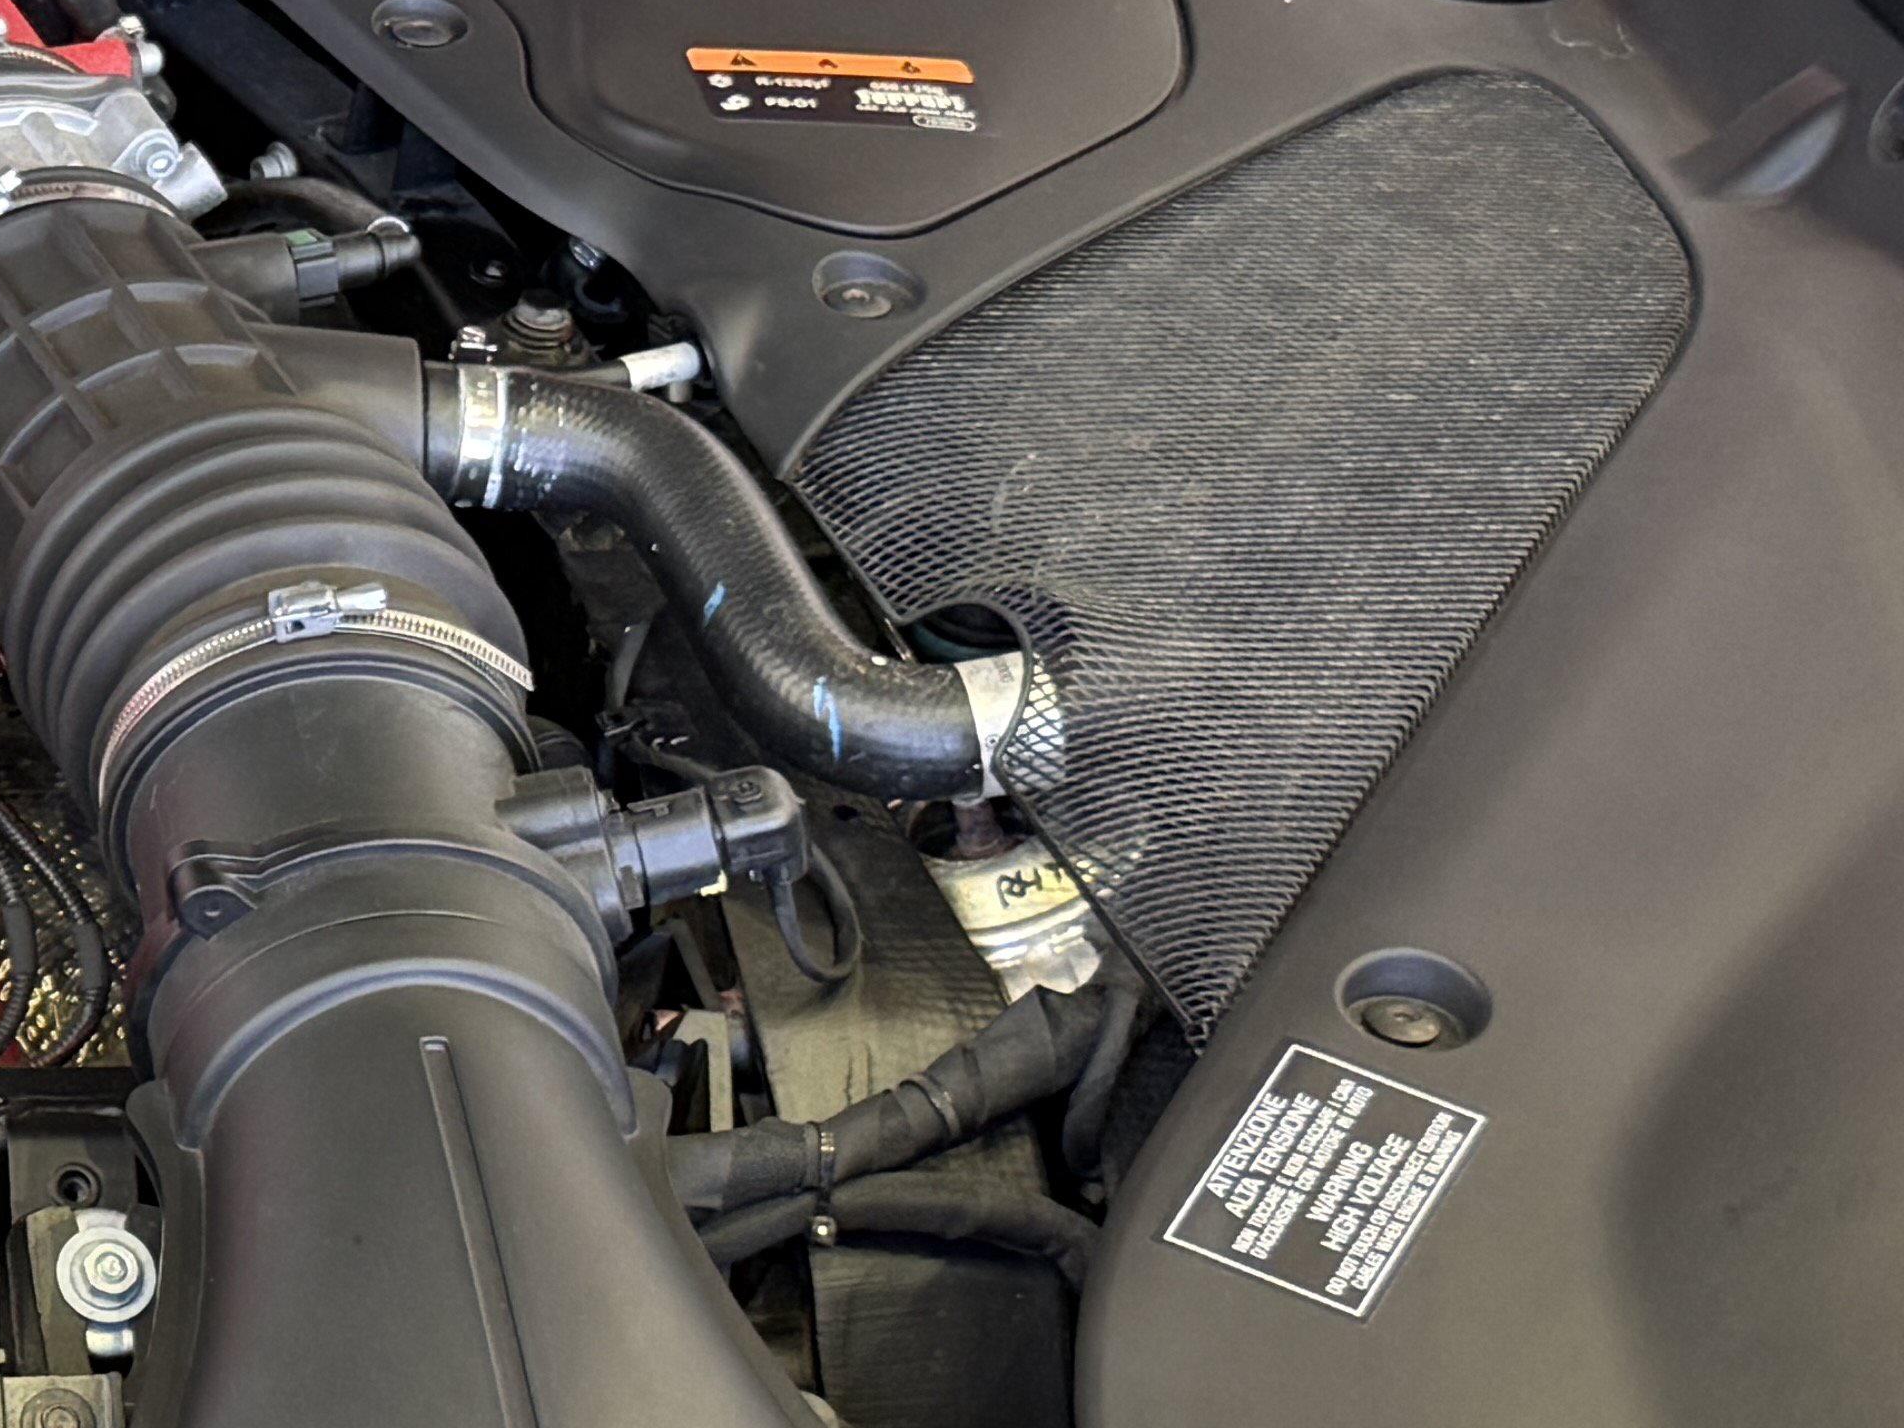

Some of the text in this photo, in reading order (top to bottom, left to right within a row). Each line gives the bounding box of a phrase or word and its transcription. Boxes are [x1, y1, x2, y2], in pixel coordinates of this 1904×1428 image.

[1202, 1091, 1289, 1199] ATTENZIONE
[1220, 1091, 1320, 1219] ALTA TENSIONE
[1246, 1183, 1287, 1228] TOCCARE
[1295, 1105, 1338, 1155] STACCARE
[1293, 1166, 1320, 1192] CON
[1308, 1127, 1346, 1169] MOTORE
[1342, 1084, 1374, 1117] MOTO
[1305, 1139, 1374, 1224] WARNING
[1319, 1132, 1411, 1252] HIGH VOLTAGE
[1368, 1207, 1392, 1227] OR
[1334, 1255, 1361, 1279] NOT
[1348, 1222, 1382, 1258] TOUCH
[1373, 1219, 1406, 1253] WHEN
[1324, 1276, 1348, 1296] DO
